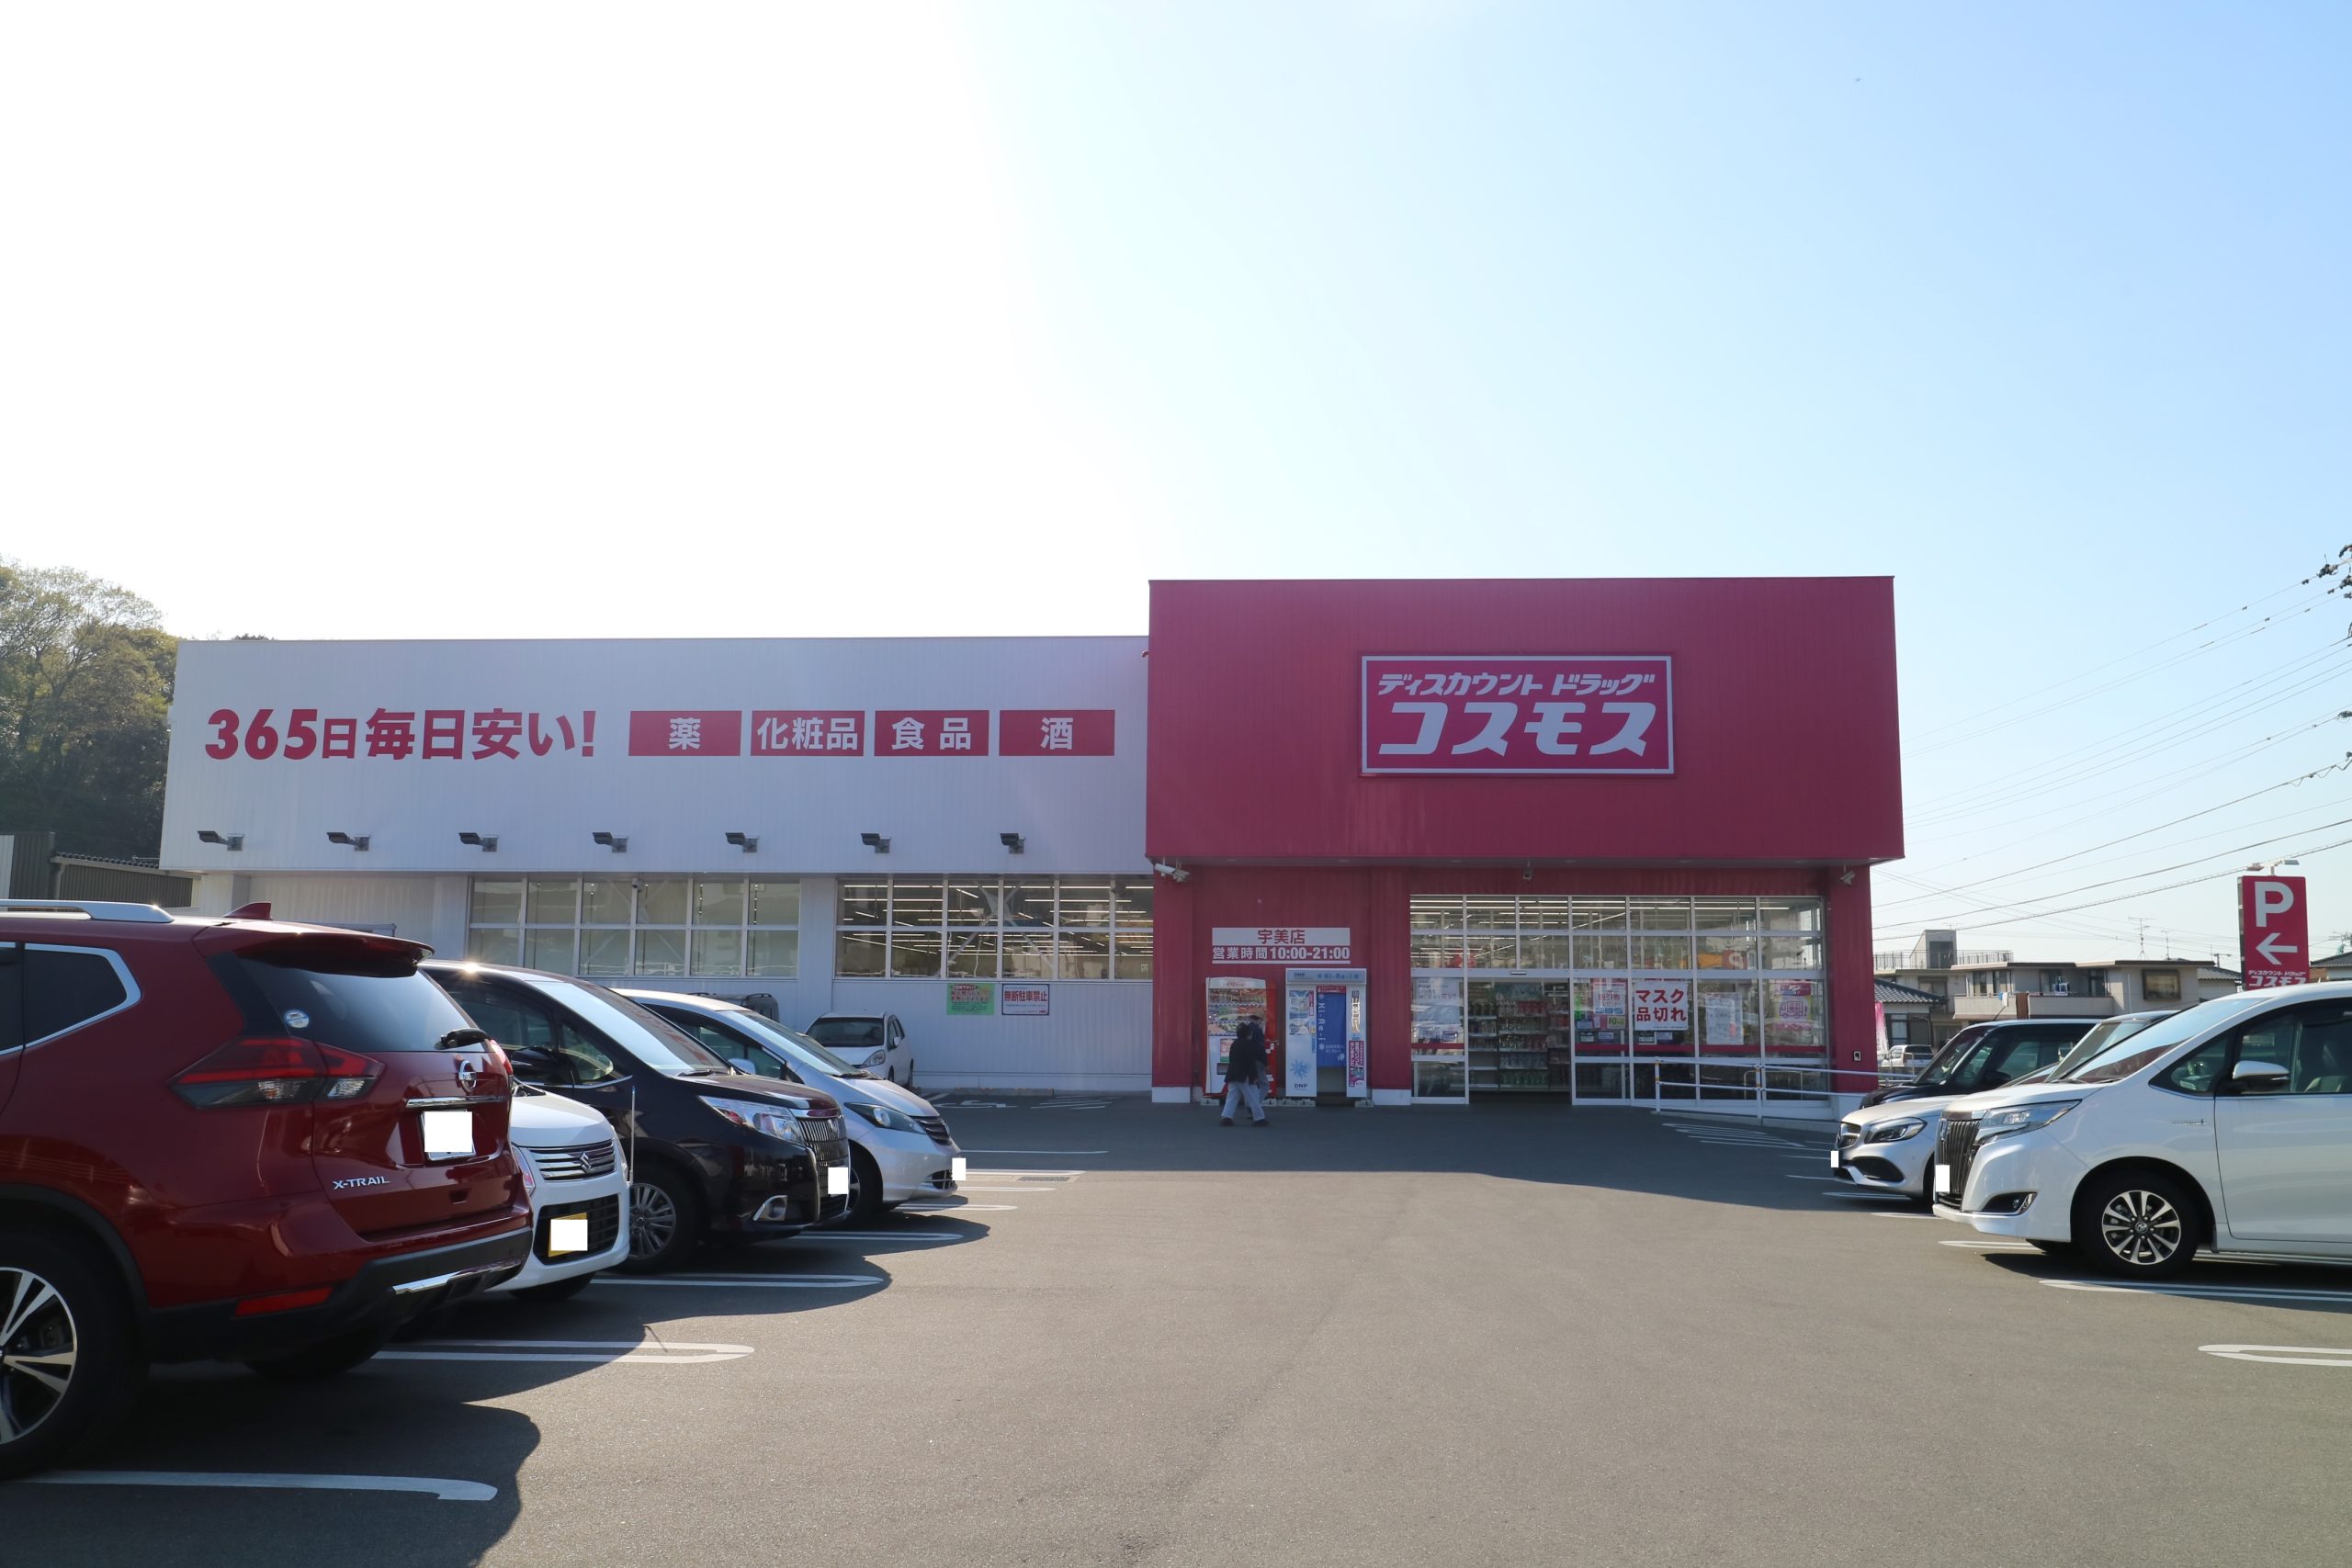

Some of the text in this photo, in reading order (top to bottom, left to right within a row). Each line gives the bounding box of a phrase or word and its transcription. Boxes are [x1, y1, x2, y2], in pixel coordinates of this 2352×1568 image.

[1378, 672, 1656, 696] ディスカウント ドラッグ
[205, 707, 596, 761] 365日毎日安い!
[668, 717, 701, 750] 薬
[756, 717, 858, 750] 化粧品
[891, 717, 972, 750] 食品
[1040, 717, 1074, 750] 酒
[1378, 702, 1657, 757] コスモス
[2255, 881, 2294, 928] P
[1258, 929, 1306, 944] 宇美店
[1003, 990, 1047, 1002] 無断駐車禁止
[1635, 988, 1684, 1004] マスク
[1636, 1007, 1687, 1021] 品切れ
[332, 1176, 390, 1190] X-TRAIL
